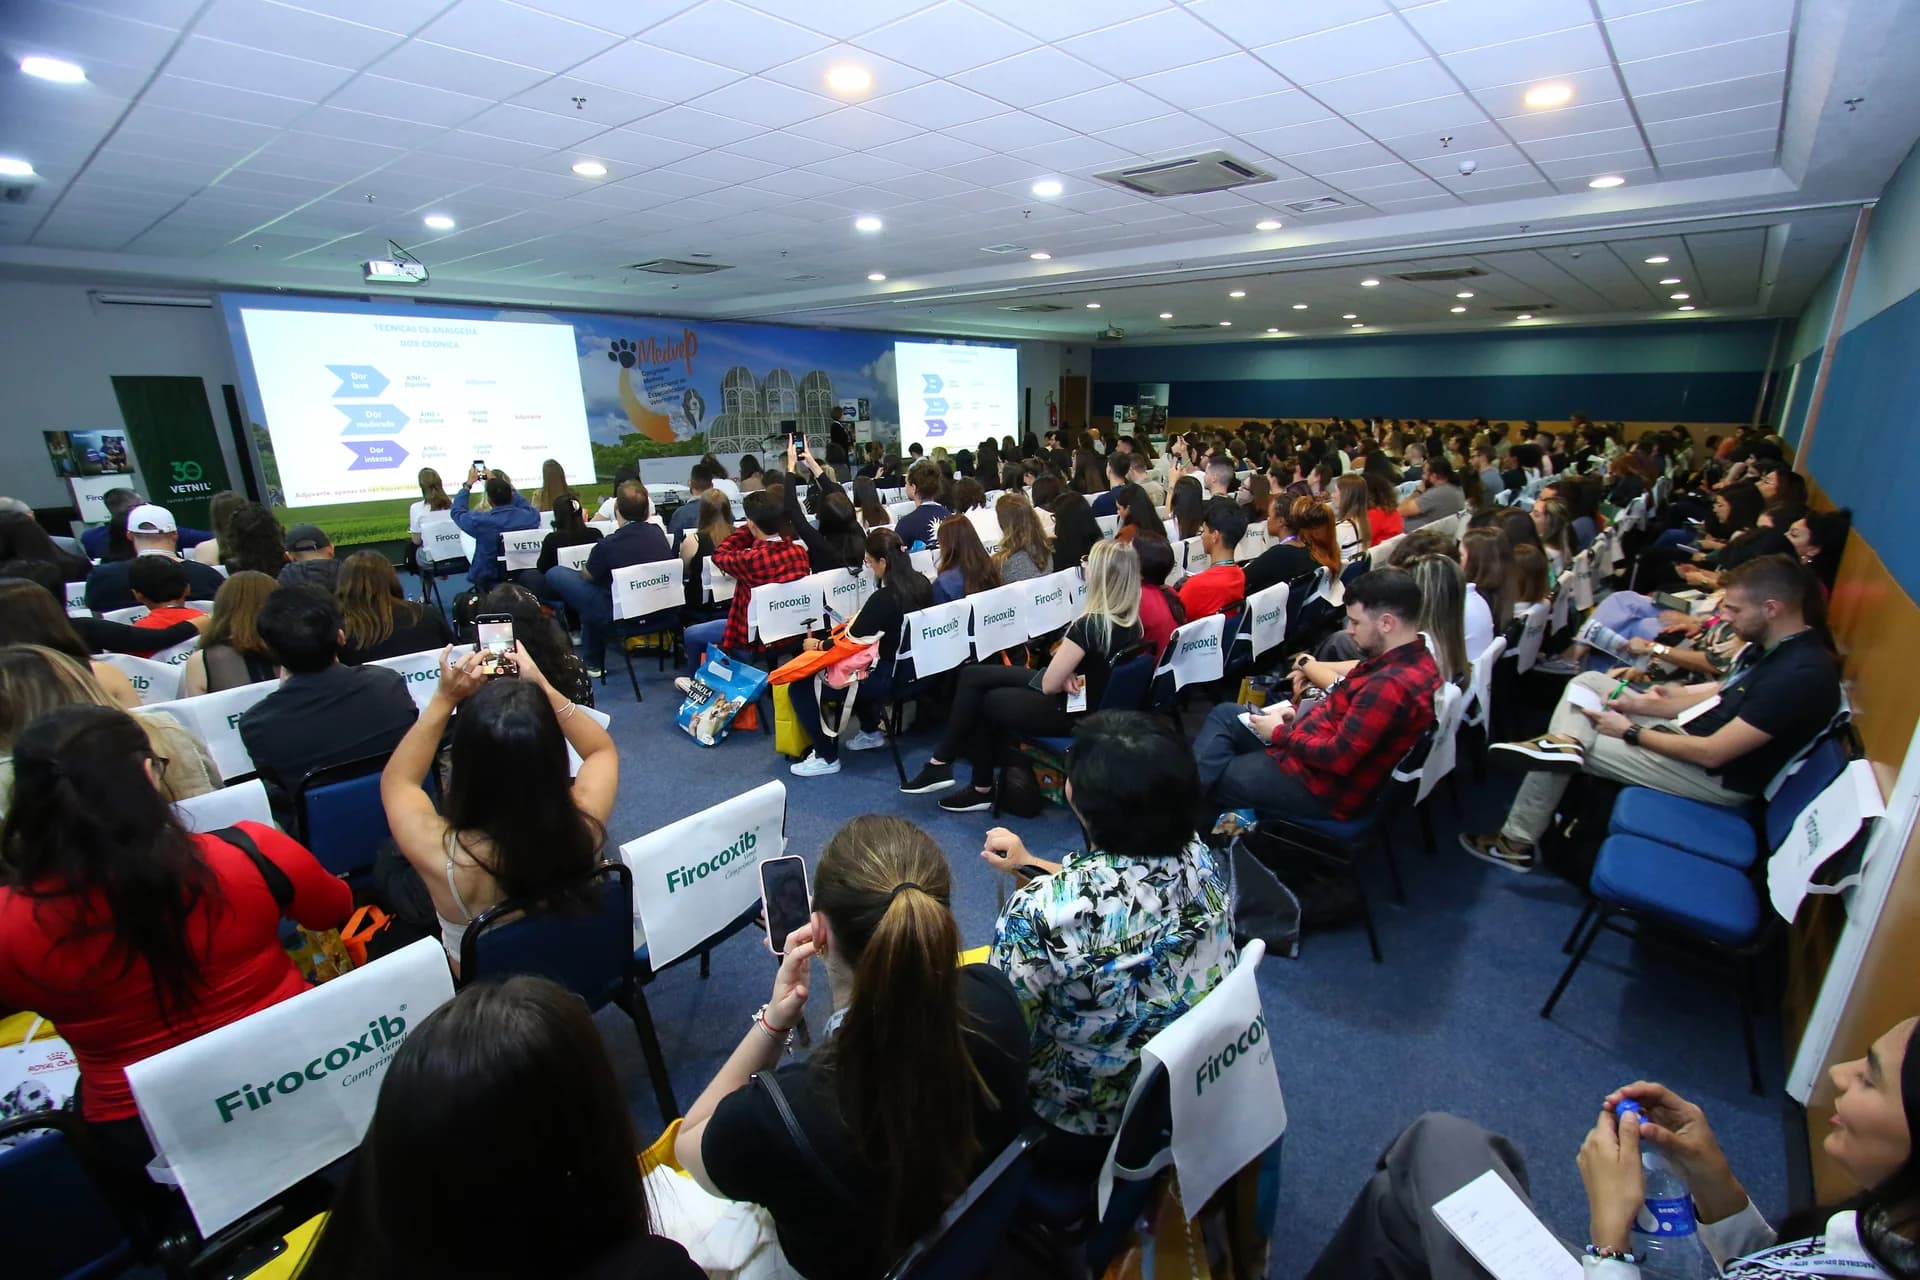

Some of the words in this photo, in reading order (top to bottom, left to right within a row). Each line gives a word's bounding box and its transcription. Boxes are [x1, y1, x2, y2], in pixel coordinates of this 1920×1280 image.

[351, 372, 368, 380] Dor
[170, 461, 202, 481] 30
[170, 483, 211, 494] VETNIL
[435, 533, 460, 542] Firoco
[513, 539, 541, 551] VETN
[630, 574, 670, 590] Firocoxib
[833, 578, 867, 597] Firocoib
[769, 594, 811, 612] Firocoxib
[1035, 587, 1063, 605] Firocoxib
[983, 607, 1016, 626] Firocoxib
[922, 618, 959, 640] Firocoxib
[1181, 634, 1218, 655] Firocoxib
[666, 831, 757, 893] Firocoxib
[1196, 1009, 1267, 1096] Firocox
[215, 1015, 406, 1123] Firocoxib
[342, 1053, 396, 1088] Comprim
